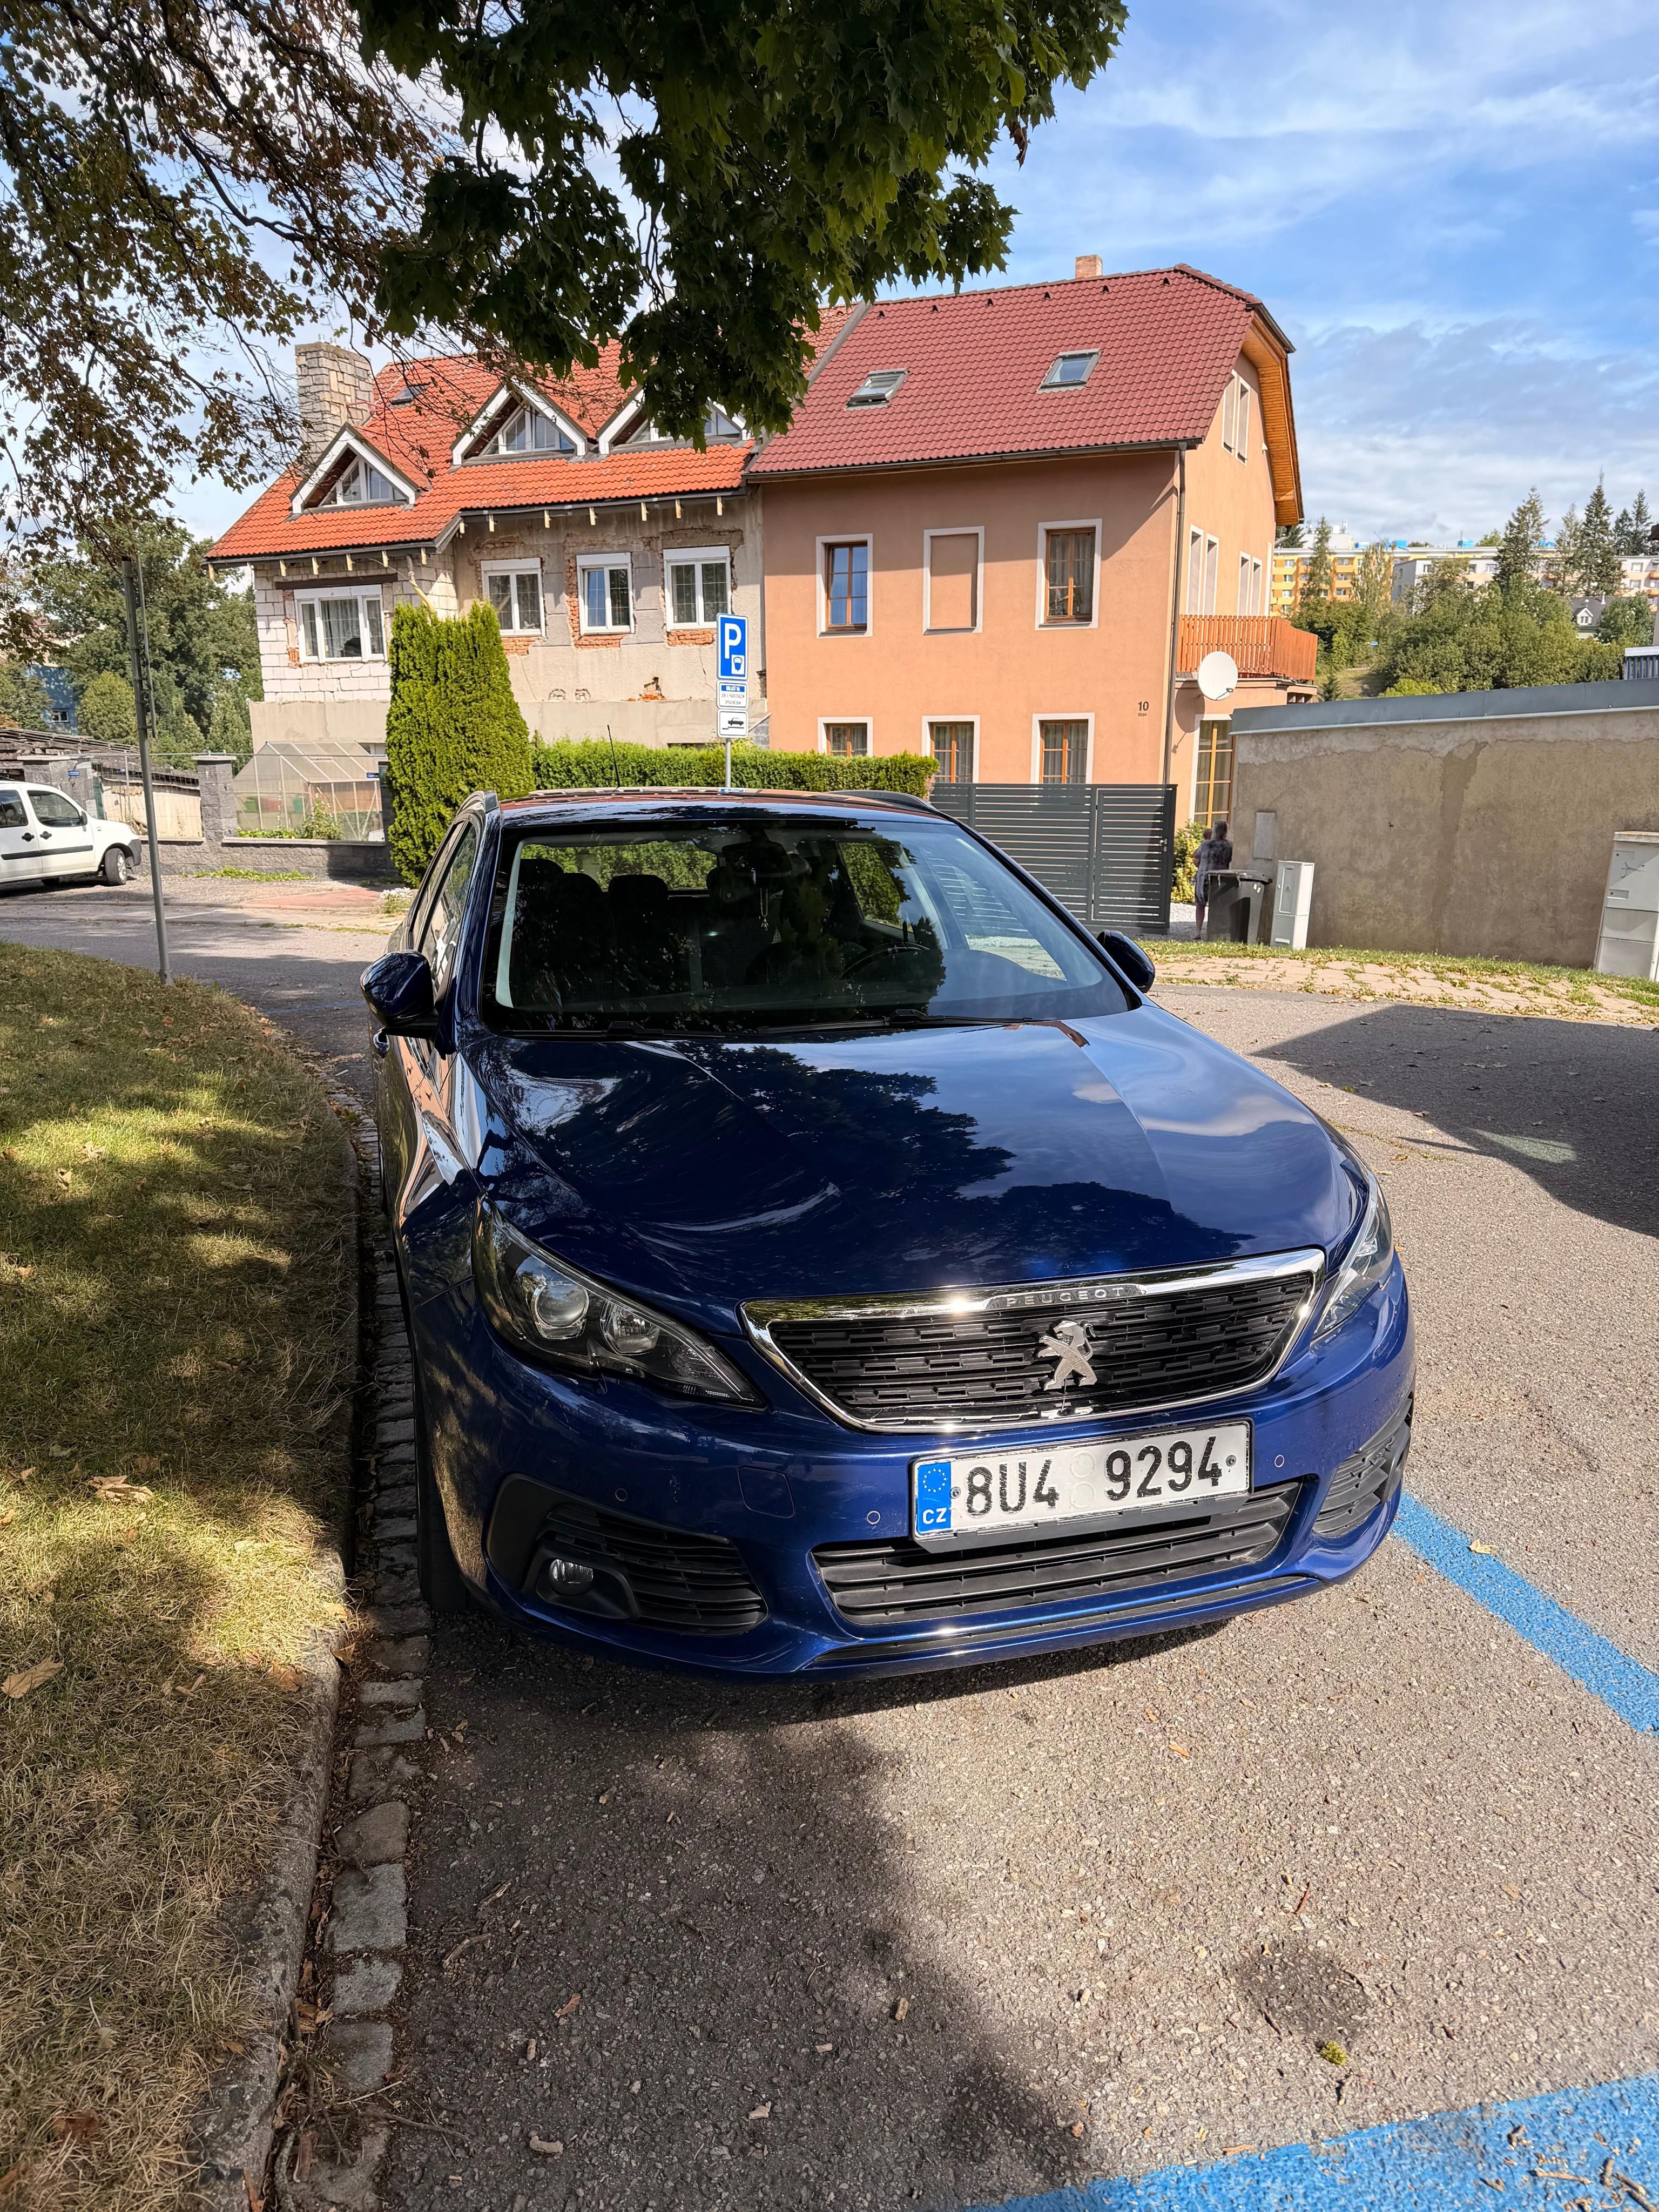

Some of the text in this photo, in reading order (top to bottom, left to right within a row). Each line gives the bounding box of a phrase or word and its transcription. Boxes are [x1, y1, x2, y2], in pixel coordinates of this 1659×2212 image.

[725, 623, 741, 659] P
[1138, 701, 1149, 711] 10
[1007, 1287, 1123, 1306] PEUGEOT
[966, 1436, 1223, 1517] 8U4 9294
[922, 1507, 947, 1525] CZ
